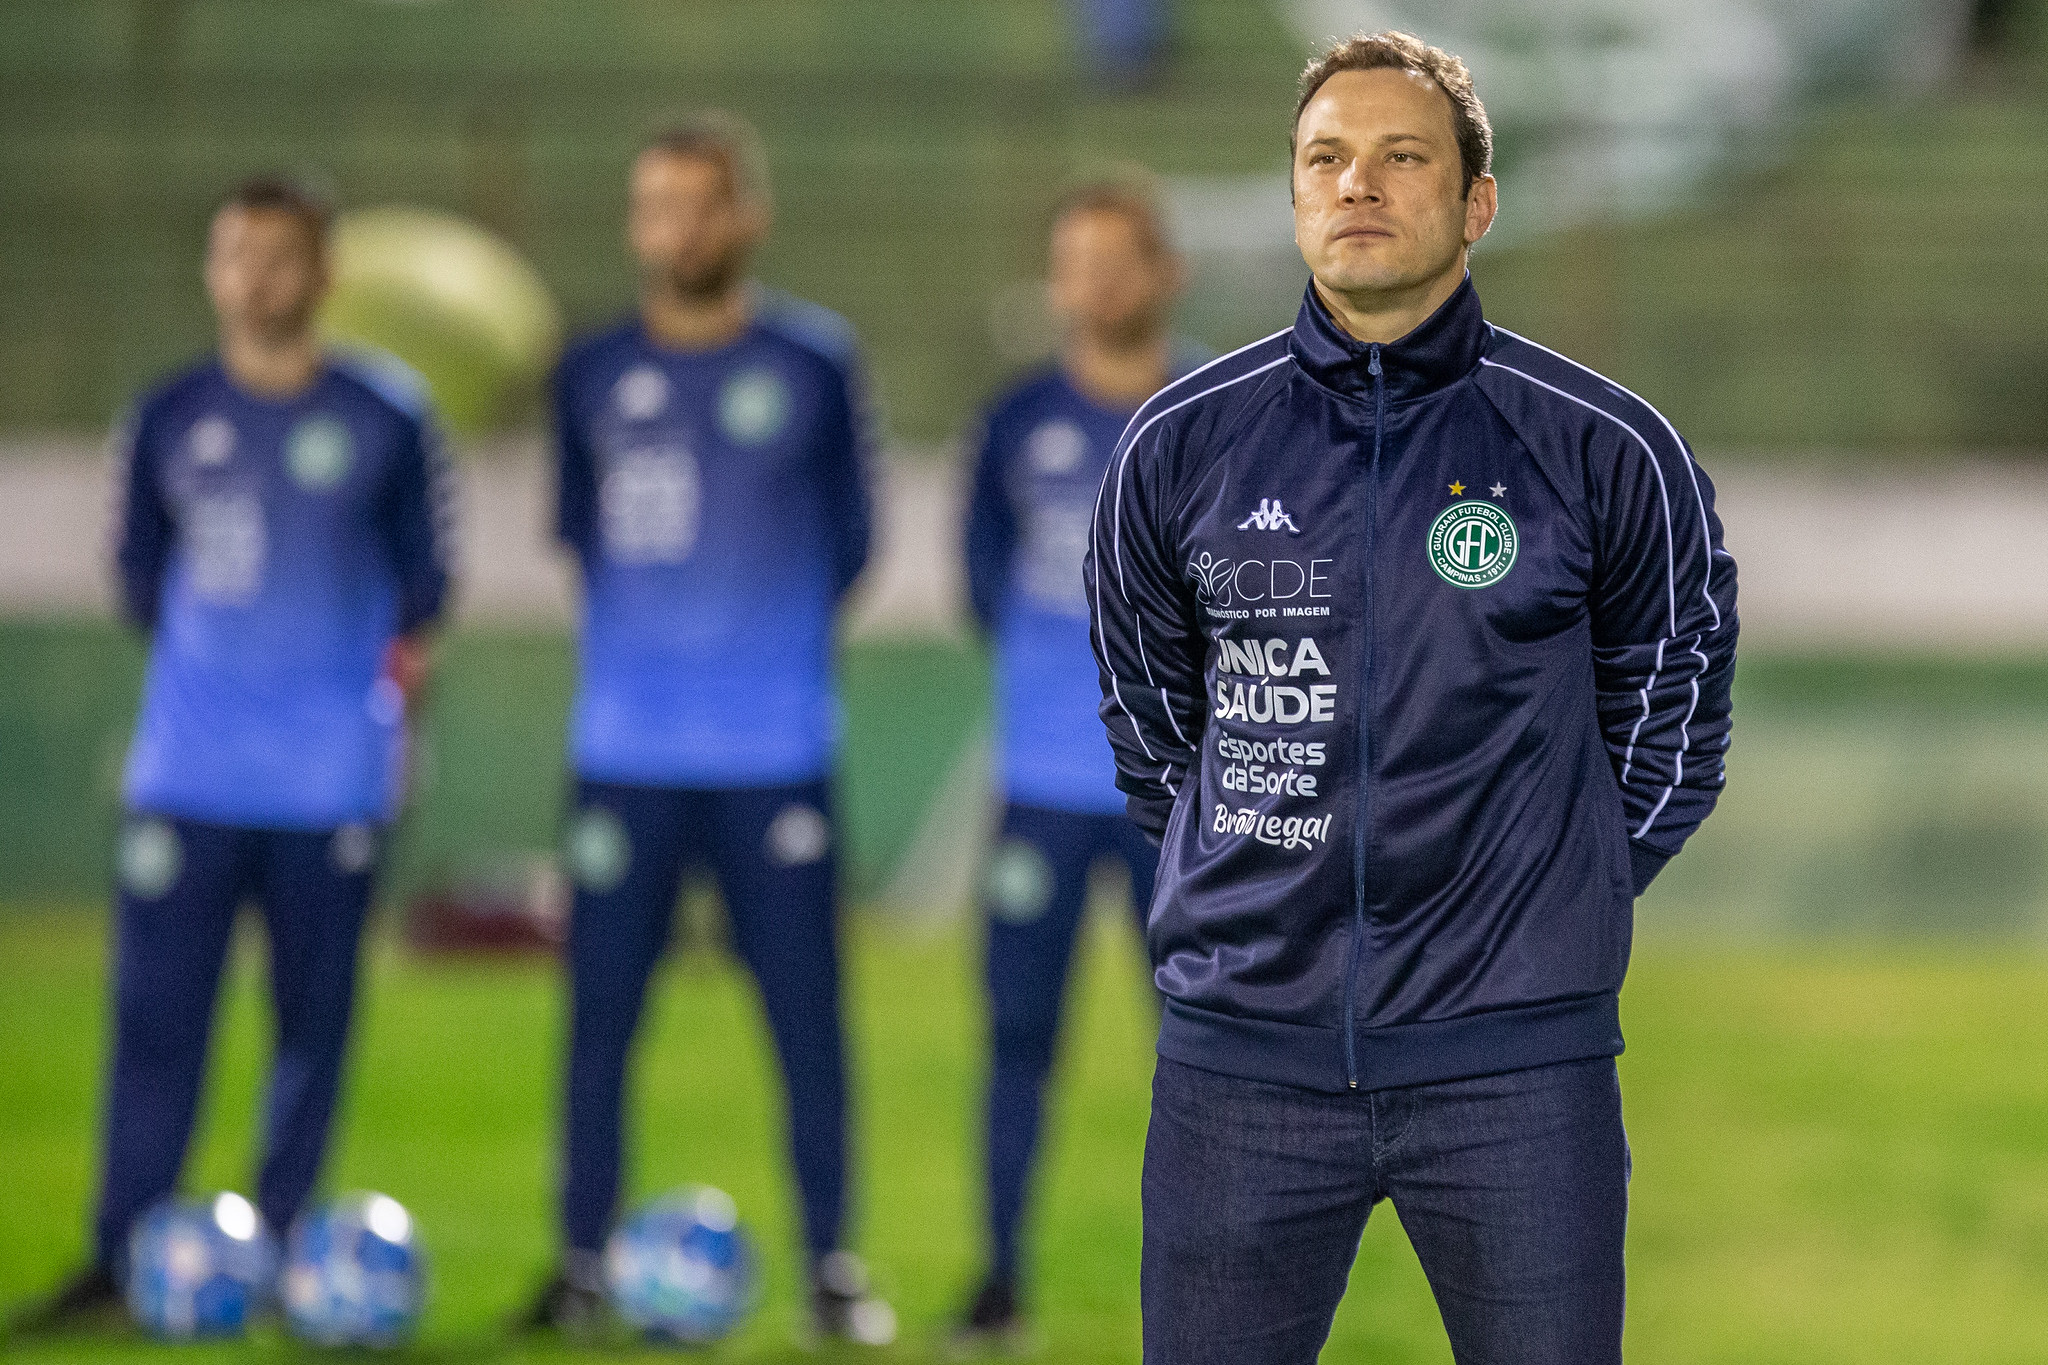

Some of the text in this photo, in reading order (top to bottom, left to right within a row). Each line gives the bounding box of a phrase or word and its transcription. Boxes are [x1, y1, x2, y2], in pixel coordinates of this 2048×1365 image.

[1433, 506, 1512, 555] GUARANI FUTEBOL CLUBE
[1234, 559, 1333, 601] CDE
[1437, 557, 1506, 583] CAMPINAS 1911
[1255, 608, 1277, 618] POR
[1283, 606, 1330, 617] IMAGEM
[1214, 676, 1337, 723] SAÚDE
[1218, 736, 1327, 766] esportes
